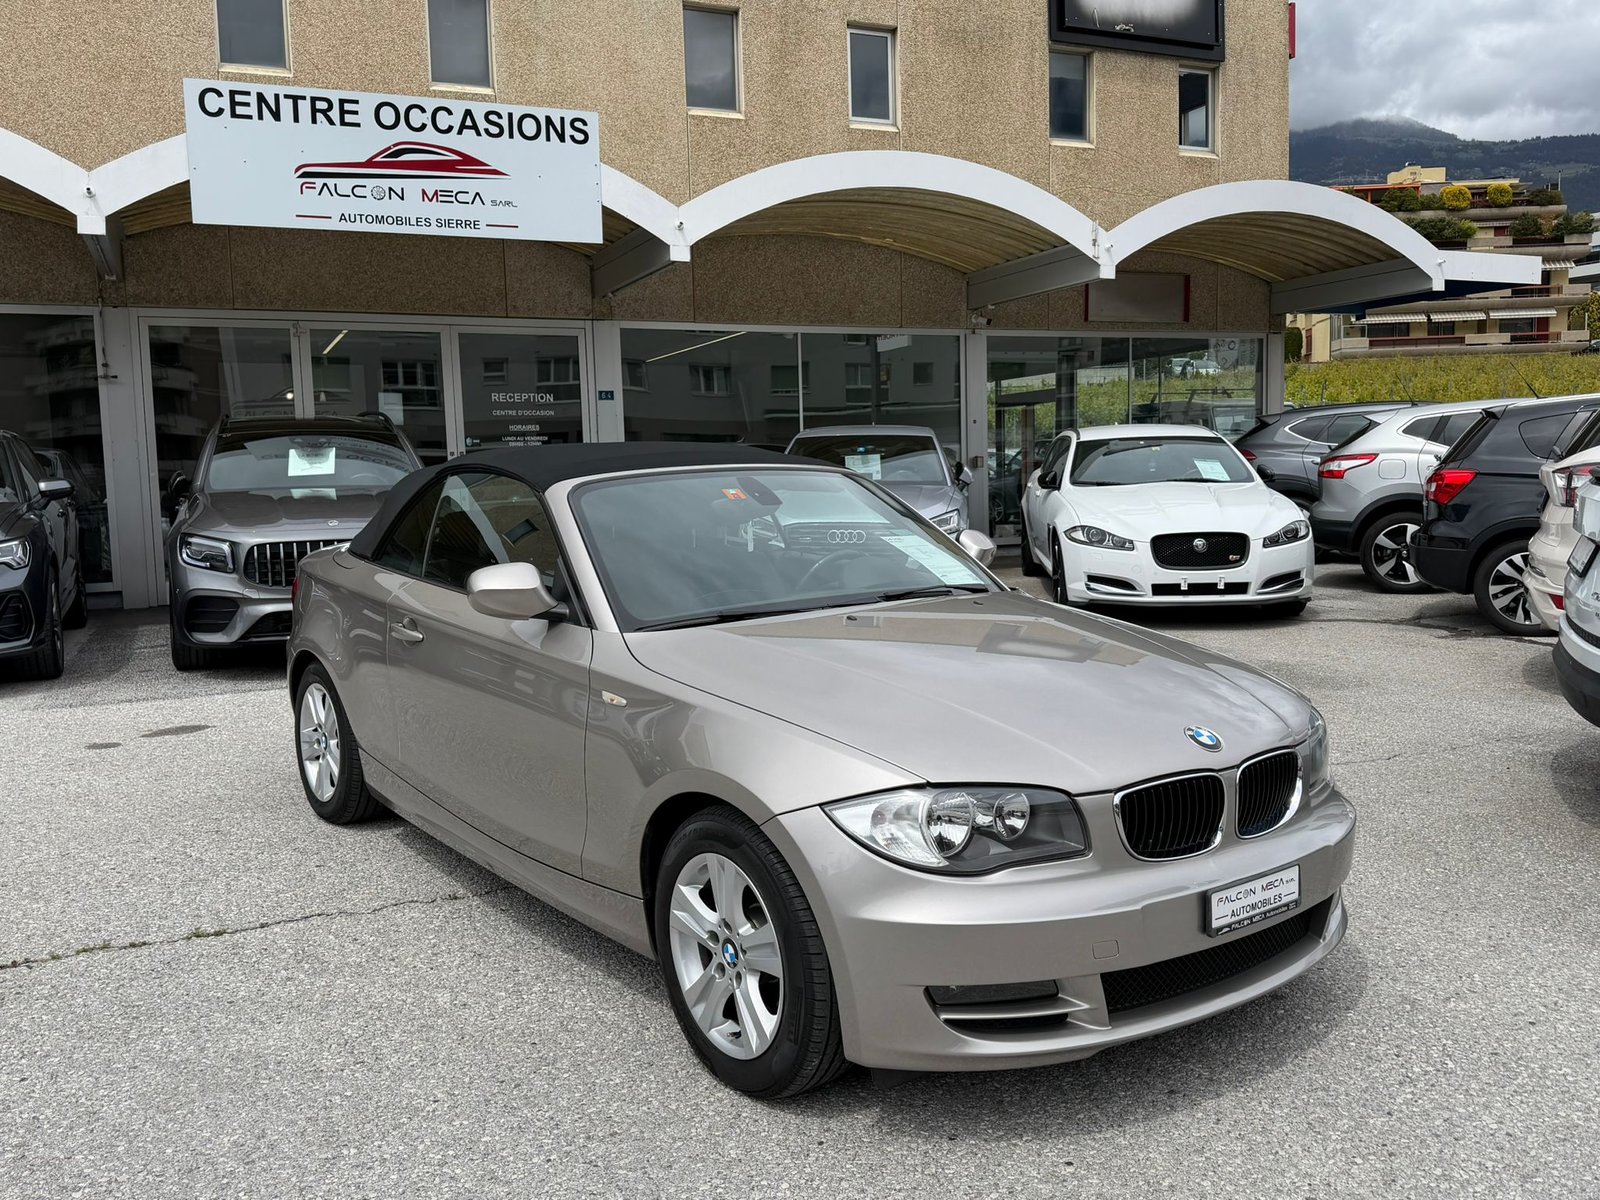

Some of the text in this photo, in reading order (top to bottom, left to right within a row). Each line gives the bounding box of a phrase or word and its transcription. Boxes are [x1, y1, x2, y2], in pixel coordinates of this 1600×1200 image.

[198, 87, 590, 145] CENTRE OCCASIONS
[300, 182, 518, 208] FALCON MECA SARL
[339, 212, 481, 230] AUTOMOBILES SIERRE
[491, 393, 554, 402] RECEPTION
[1217, 887, 1256, 906] FALCON
[1261, 878, 1284, 892] MECA
[1230, 893, 1283, 919] AUTOMOBILES
[1231, 918, 1251, 930] FALCON
